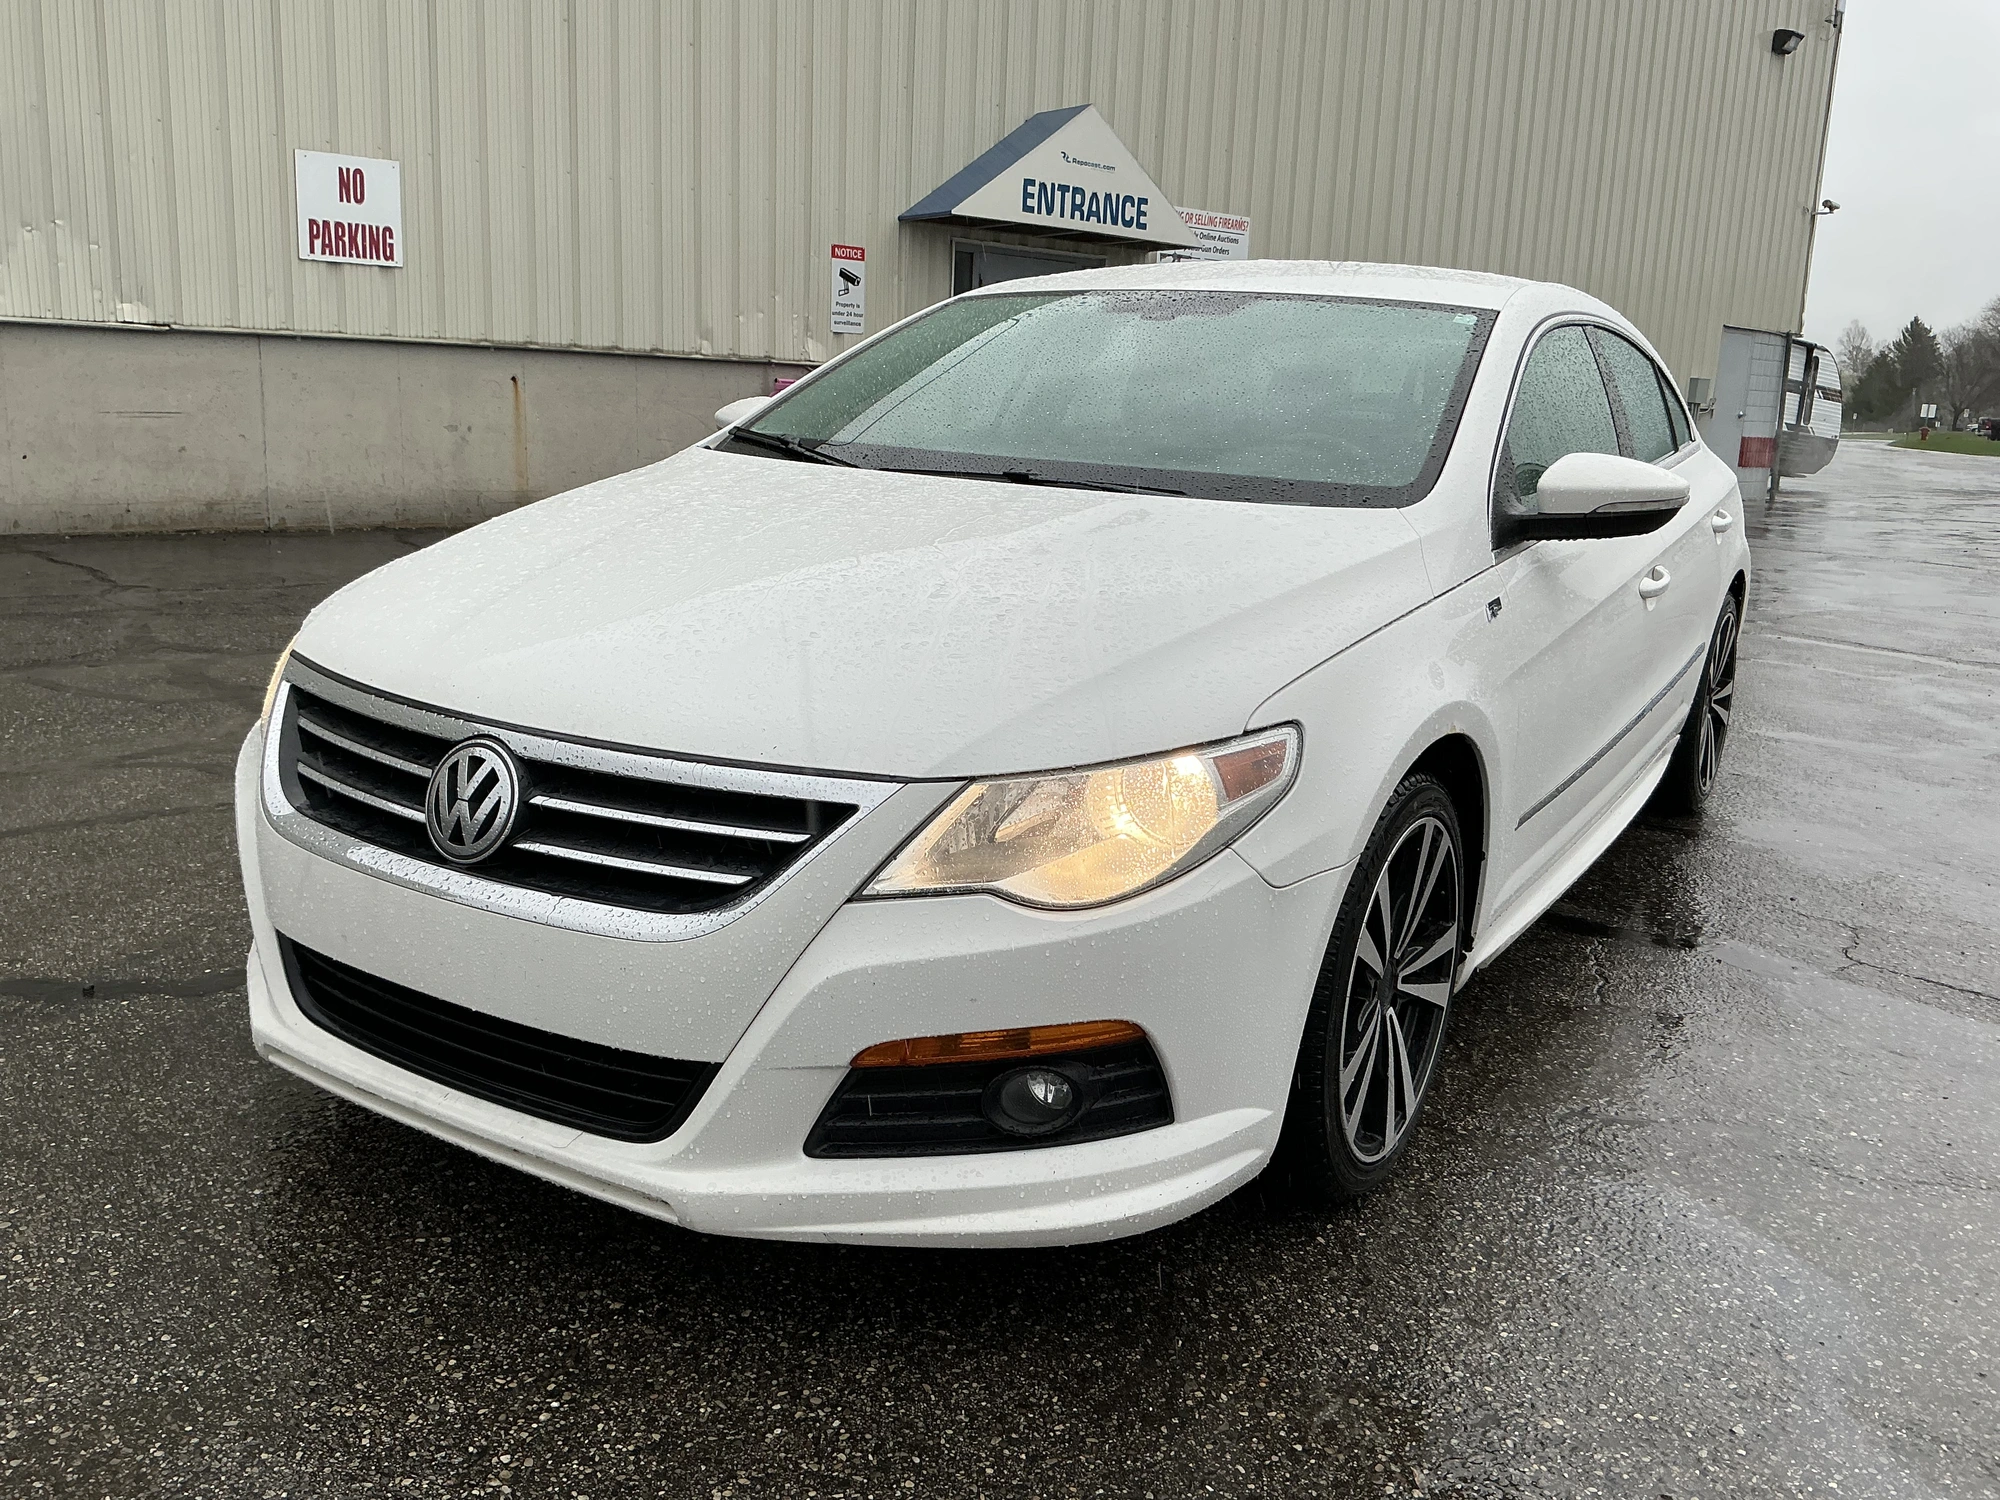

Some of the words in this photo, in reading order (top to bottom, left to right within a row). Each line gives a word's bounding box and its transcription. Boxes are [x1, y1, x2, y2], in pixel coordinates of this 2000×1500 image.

[1072, 157, 1116, 171] Repocast.com
[338, 166, 365, 205] NO
[1022, 178, 1149, 230] ENTRANCE
[1185, 212, 1194, 224] OR
[1194, 214, 1217, 227] SELLING
[1218, 217, 1249, 231] FIREARMS?
[308, 218, 394, 262] PARKING
[1199, 232, 1216, 241] Online
[1217, 235, 1239, 244] Auctions
[834, 247, 862, 259] NOTICE
[1213, 246, 1229, 255] Orders
[835, 301, 855, 309] Property
